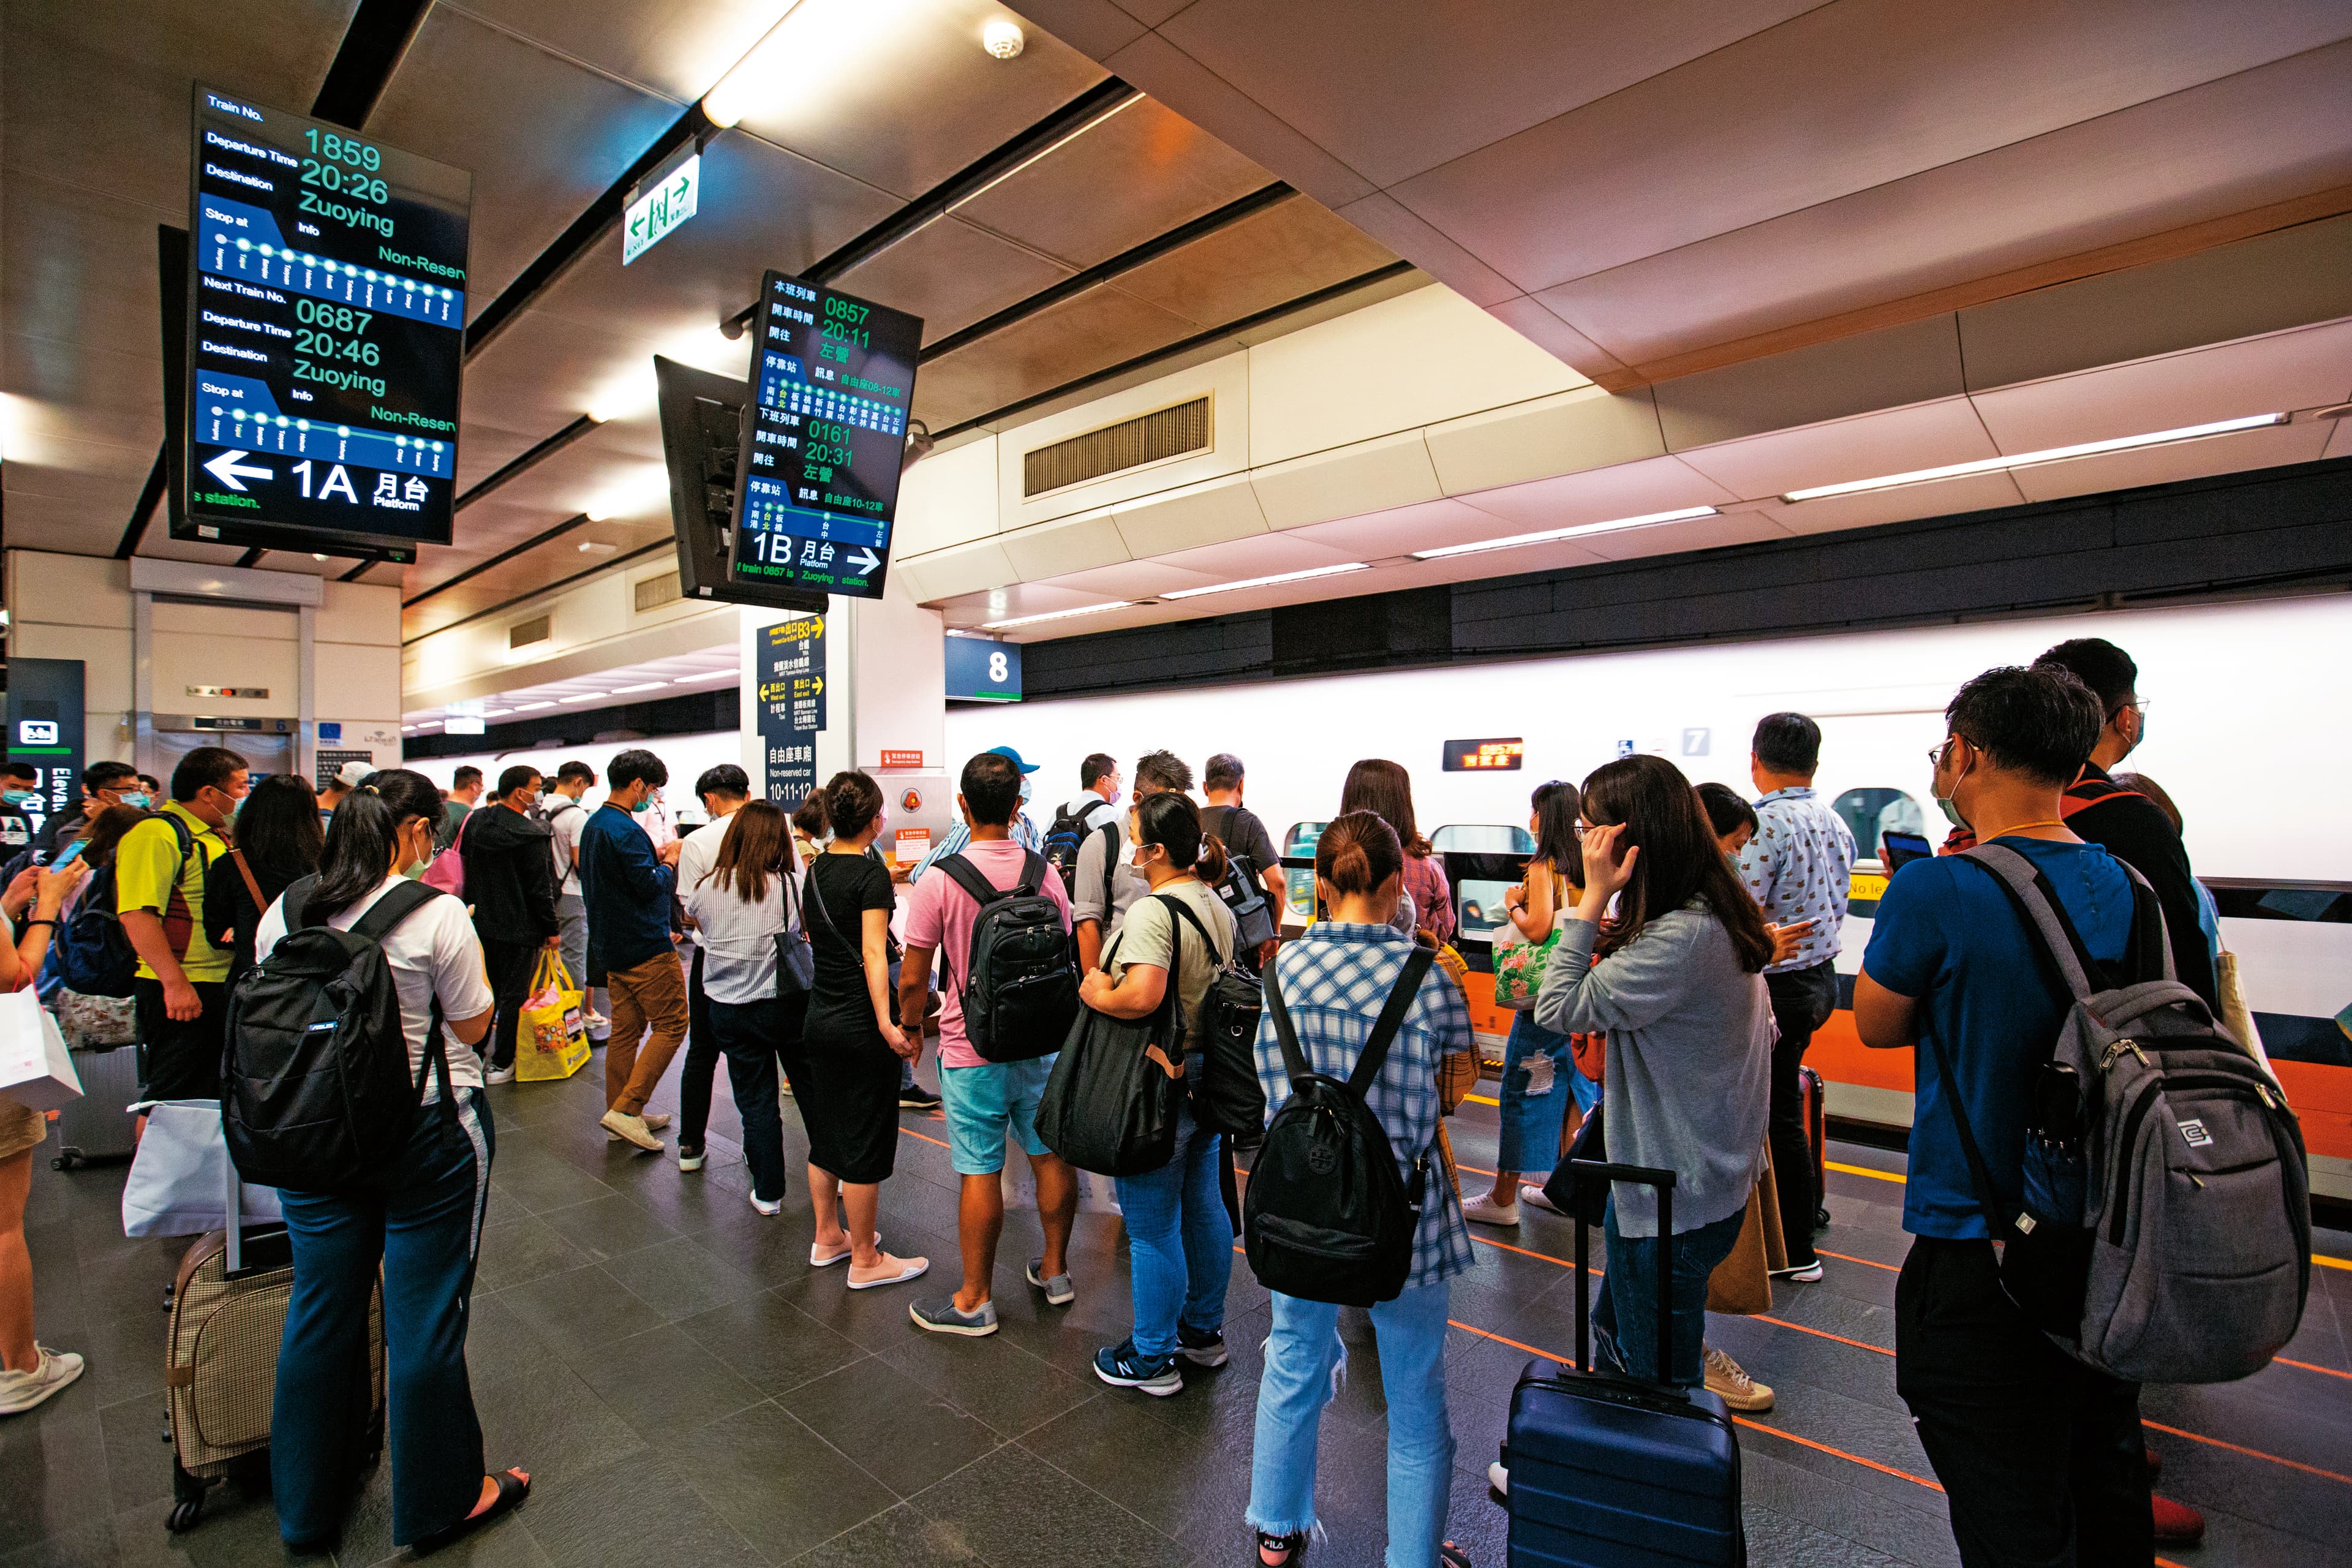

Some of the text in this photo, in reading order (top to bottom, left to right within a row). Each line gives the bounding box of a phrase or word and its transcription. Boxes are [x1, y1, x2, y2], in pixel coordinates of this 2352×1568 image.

[207, 94, 264, 123] Train No.
[206, 131, 299, 168] Departure Time
[305, 128, 382, 172] 1859
[206, 163, 273, 192] Destination
[301, 158, 389, 205] 20:26
[205, 208, 249, 228] Stop at
[298, 190, 394, 238] Zuoying
[298, 221, 320, 237] Info
[204, 276, 287, 304] Next Train No.
[774, 279, 817, 303] 本班列車
[296, 298, 372, 336] 0687
[771, 303, 814, 326] 開車時間
[825, 296, 870, 325] 0857
[203, 310, 292, 339] Departure Time
[769, 326, 791, 342] 開往
[821, 319, 870, 349] 20:11
[202, 341, 268, 363] Destination
[294, 328, 380, 366] 20:46
[819, 341, 850, 364] 左營
[766, 355, 797, 374] 停靠站
[815, 366, 835, 382] 訊息
[292, 358, 386, 398] Zuoying
[202, 382, 244, 399] Stop at
[292, 388, 314, 402] Info
[777, 388, 788, 409] 台北
[759, 407, 800, 427] 下班列車
[813, 397, 824, 417] 新竹
[837, 403, 846, 423] 台中
[756, 429, 797, 450] 開車時間
[809, 420, 851, 445] 0161
[753, 452, 775, 467] 開往
[805, 442, 853, 467] 20:31
[292, 459, 359, 505] 1A
[803, 463, 833, 484] 左營
[374, 473, 429, 502] 月台
[750, 480, 782, 497] 停靠站
[799, 486, 818, 501] 訊息
[205, 492, 261, 508] station.
[373, 495, 420, 511] Platform
[762, 512, 772, 531] 台北
[821, 521, 829, 540] 台中
[753, 532, 792, 564] 1B
[800, 540, 835, 562] 月台
[799, 558, 828, 570] Platform
[742, 563, 762, 574] train
[786, 568, 794, 578] is
[801, 570, 834, 584] Zuoying
[842, 576, 869, 587] station.
[797, 620, 810, 639] B3
[989, 652, 1008, 682] 8
[770, 682, 785, 693] 西出口
[794, 679, 810, 690] 東出口
[1687, 729, 1706, 754] 7
[770, 745, 812, 764] 自由座車廂
[770, 767, 802, 777] Non-reserved
[1850, 883, 1866, 894] No
[1264, 1538, 1284, 1549] FILA
